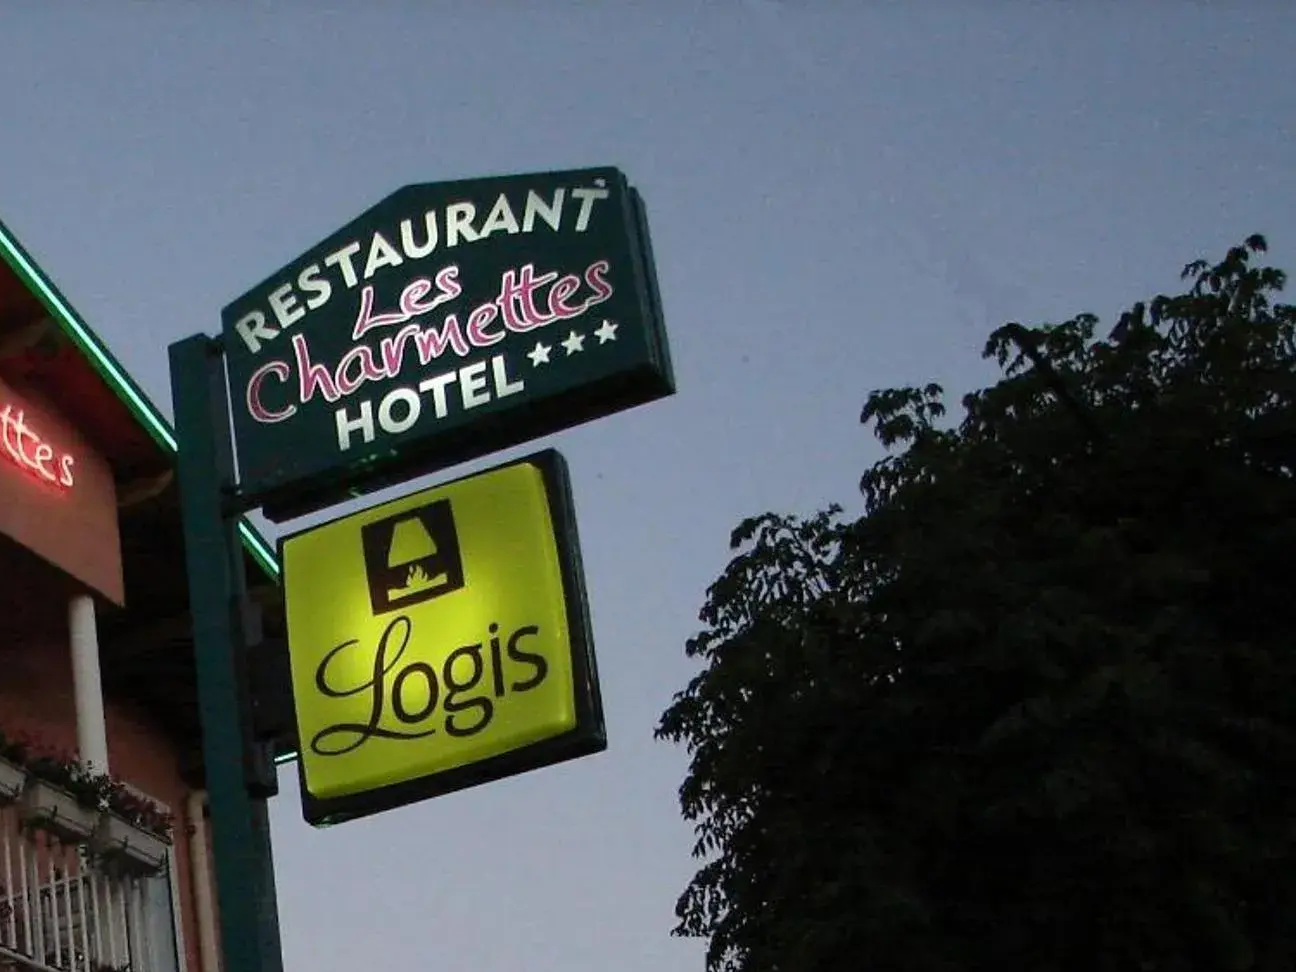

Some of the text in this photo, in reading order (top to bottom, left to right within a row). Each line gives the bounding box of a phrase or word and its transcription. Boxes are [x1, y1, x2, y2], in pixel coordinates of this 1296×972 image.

[234, 186, 610, 355] RESTAURANT
[351, 264, 463, 341] Les
[245, 259, 614, 424] Charmettes
[333, 354, 525, 452] HOTEL
[310, 615, 548, 756] Logis
